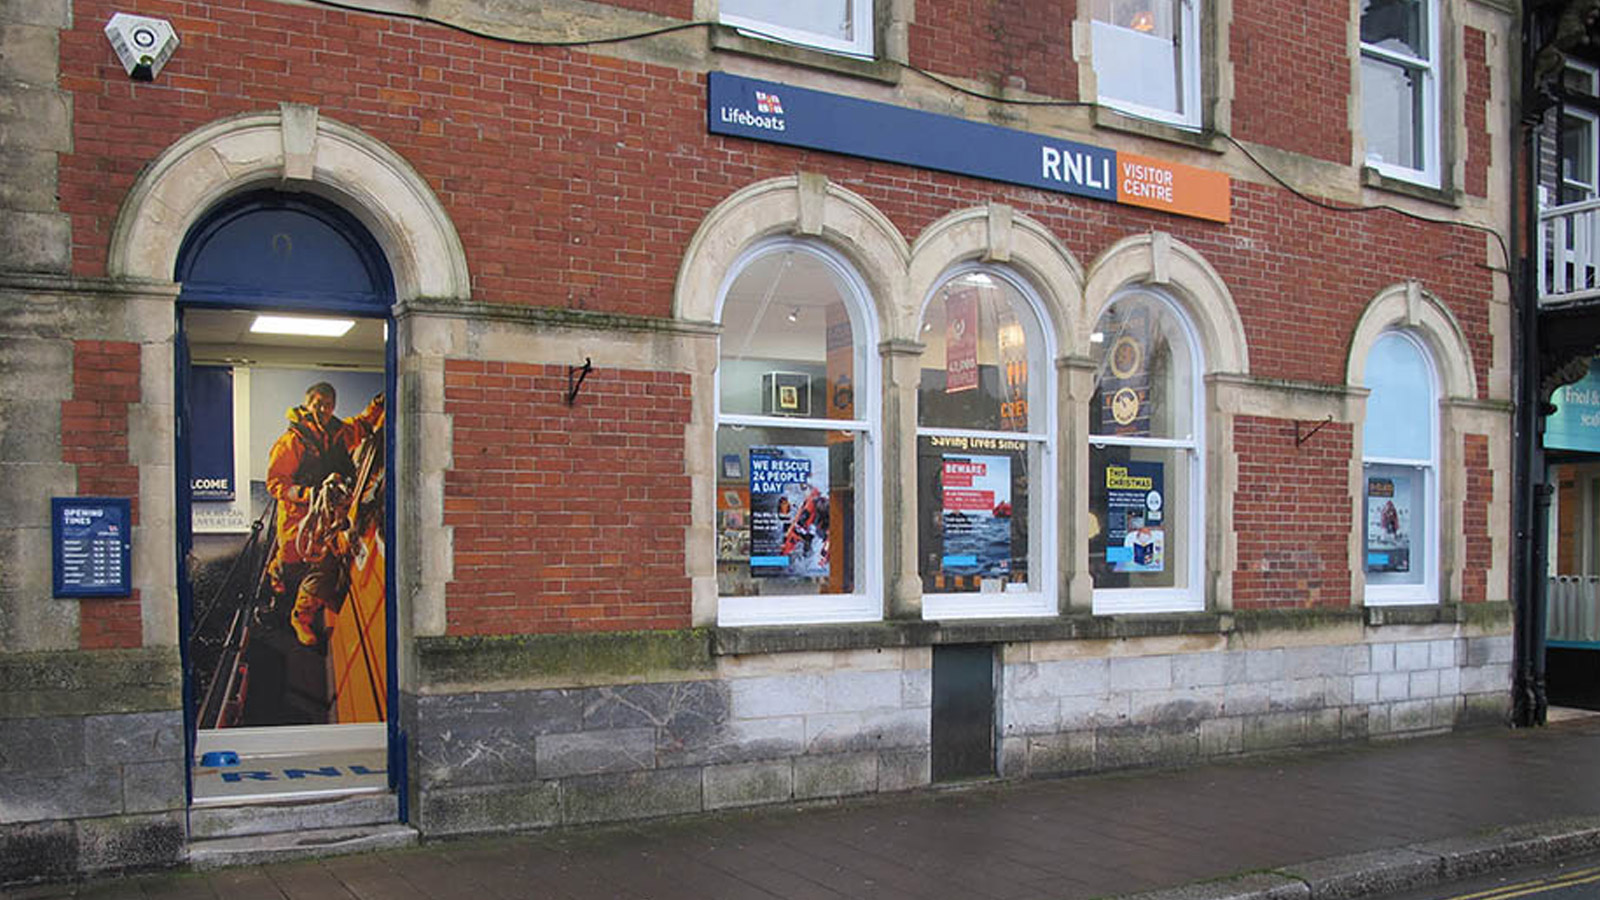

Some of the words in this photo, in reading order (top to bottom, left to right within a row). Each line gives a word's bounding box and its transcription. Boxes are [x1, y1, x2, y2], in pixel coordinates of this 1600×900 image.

[721, 107, 785, 131] Lifeboats
[1042, 146, 1110, 190] RNLI
[1123, 162, 1173, 186] VISITOR
[1123, 179, 1173, 203] CENTRE
[931, 435, 968, 449] Saving
[971, 437, 996, 449] lives
[998, 440, 1025, 450] since
[752, 460, 769, 471] WE
[772, 461, 810, 472] RESCUE
[752, 471, 766, 482] 24
[767, 472, 806, 483] PEOPLE
[1109, 468, 1127, 477] THIS
[752, 483, 761, 493] A
[762, 483, 783, 493] DAY
[1109, 478, 1151, 488] CHRISTMAS
[64, 509, 104, 518] OPENING
[64, 517, 92, 525] TIMES
